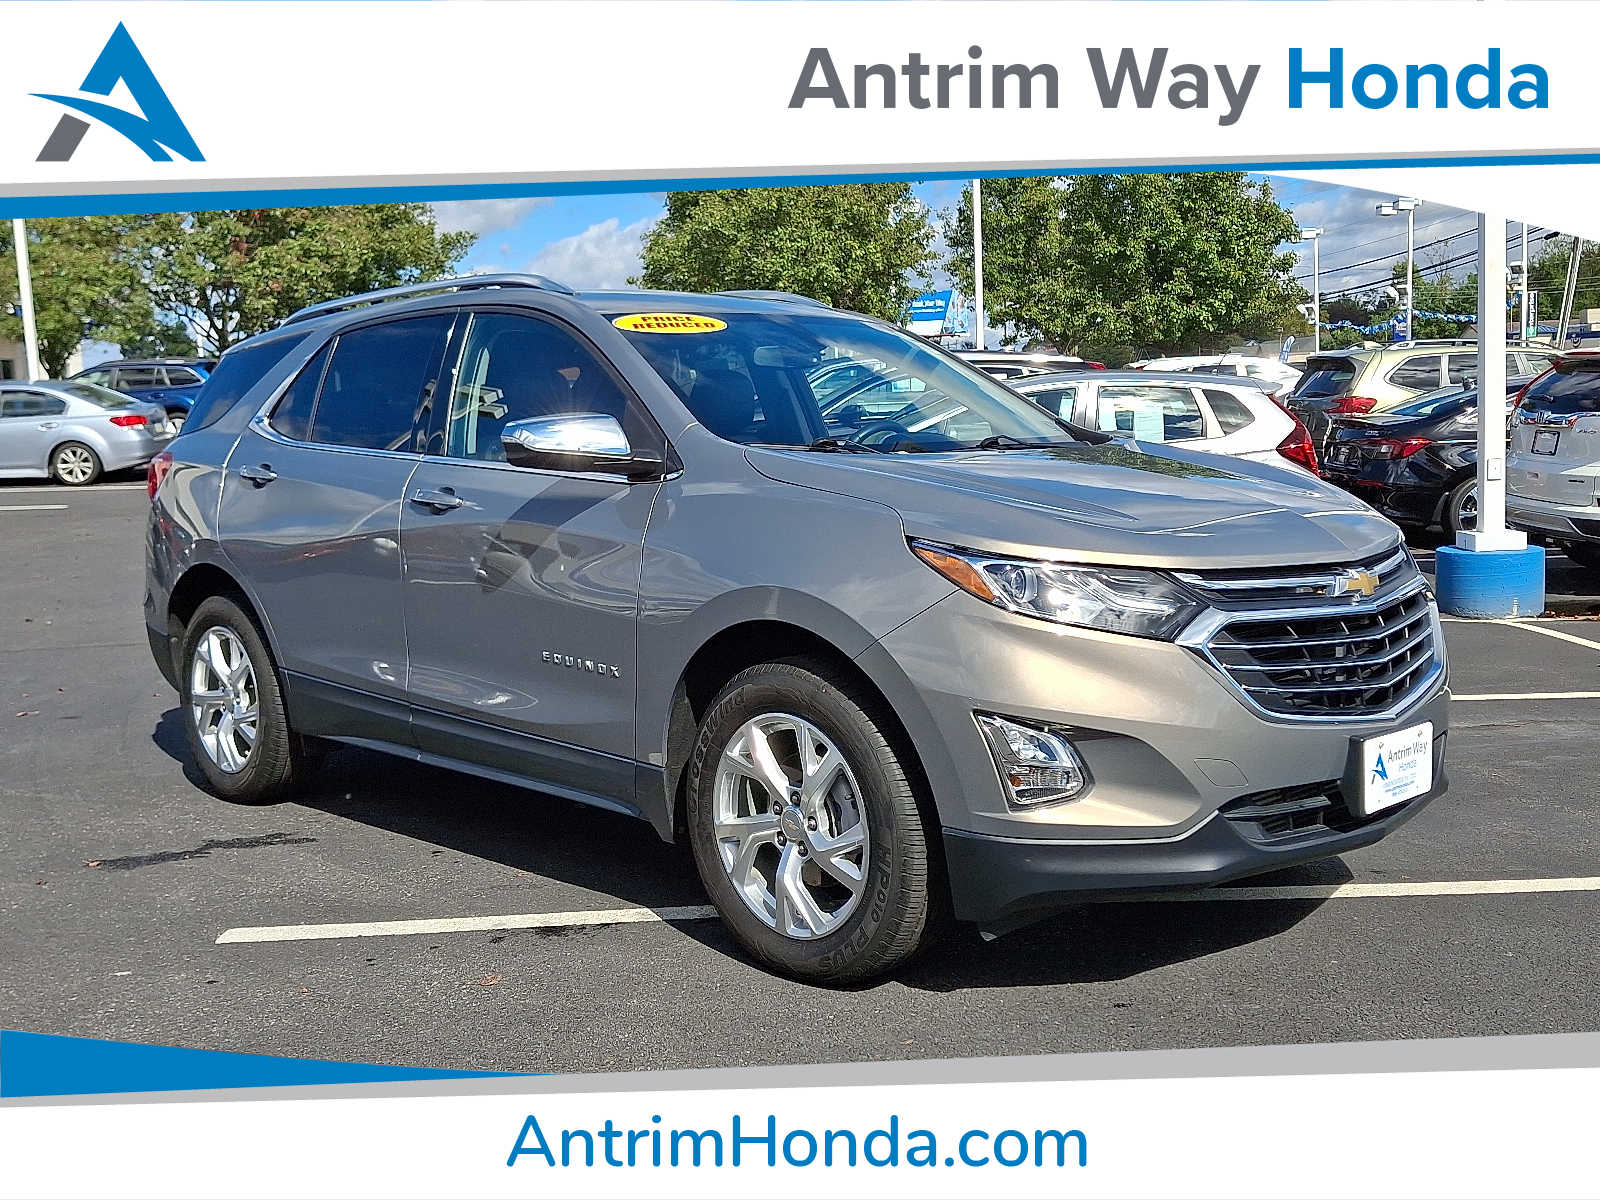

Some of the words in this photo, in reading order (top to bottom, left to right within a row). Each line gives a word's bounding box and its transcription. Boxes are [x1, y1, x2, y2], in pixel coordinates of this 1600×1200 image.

[632, 322, 716, 330] REDUCED
[542, 650, 620, 678] EQUINOX
[1388, 745, 1412, 763] Antrim
[1412, 741, 1428, 755] Way
